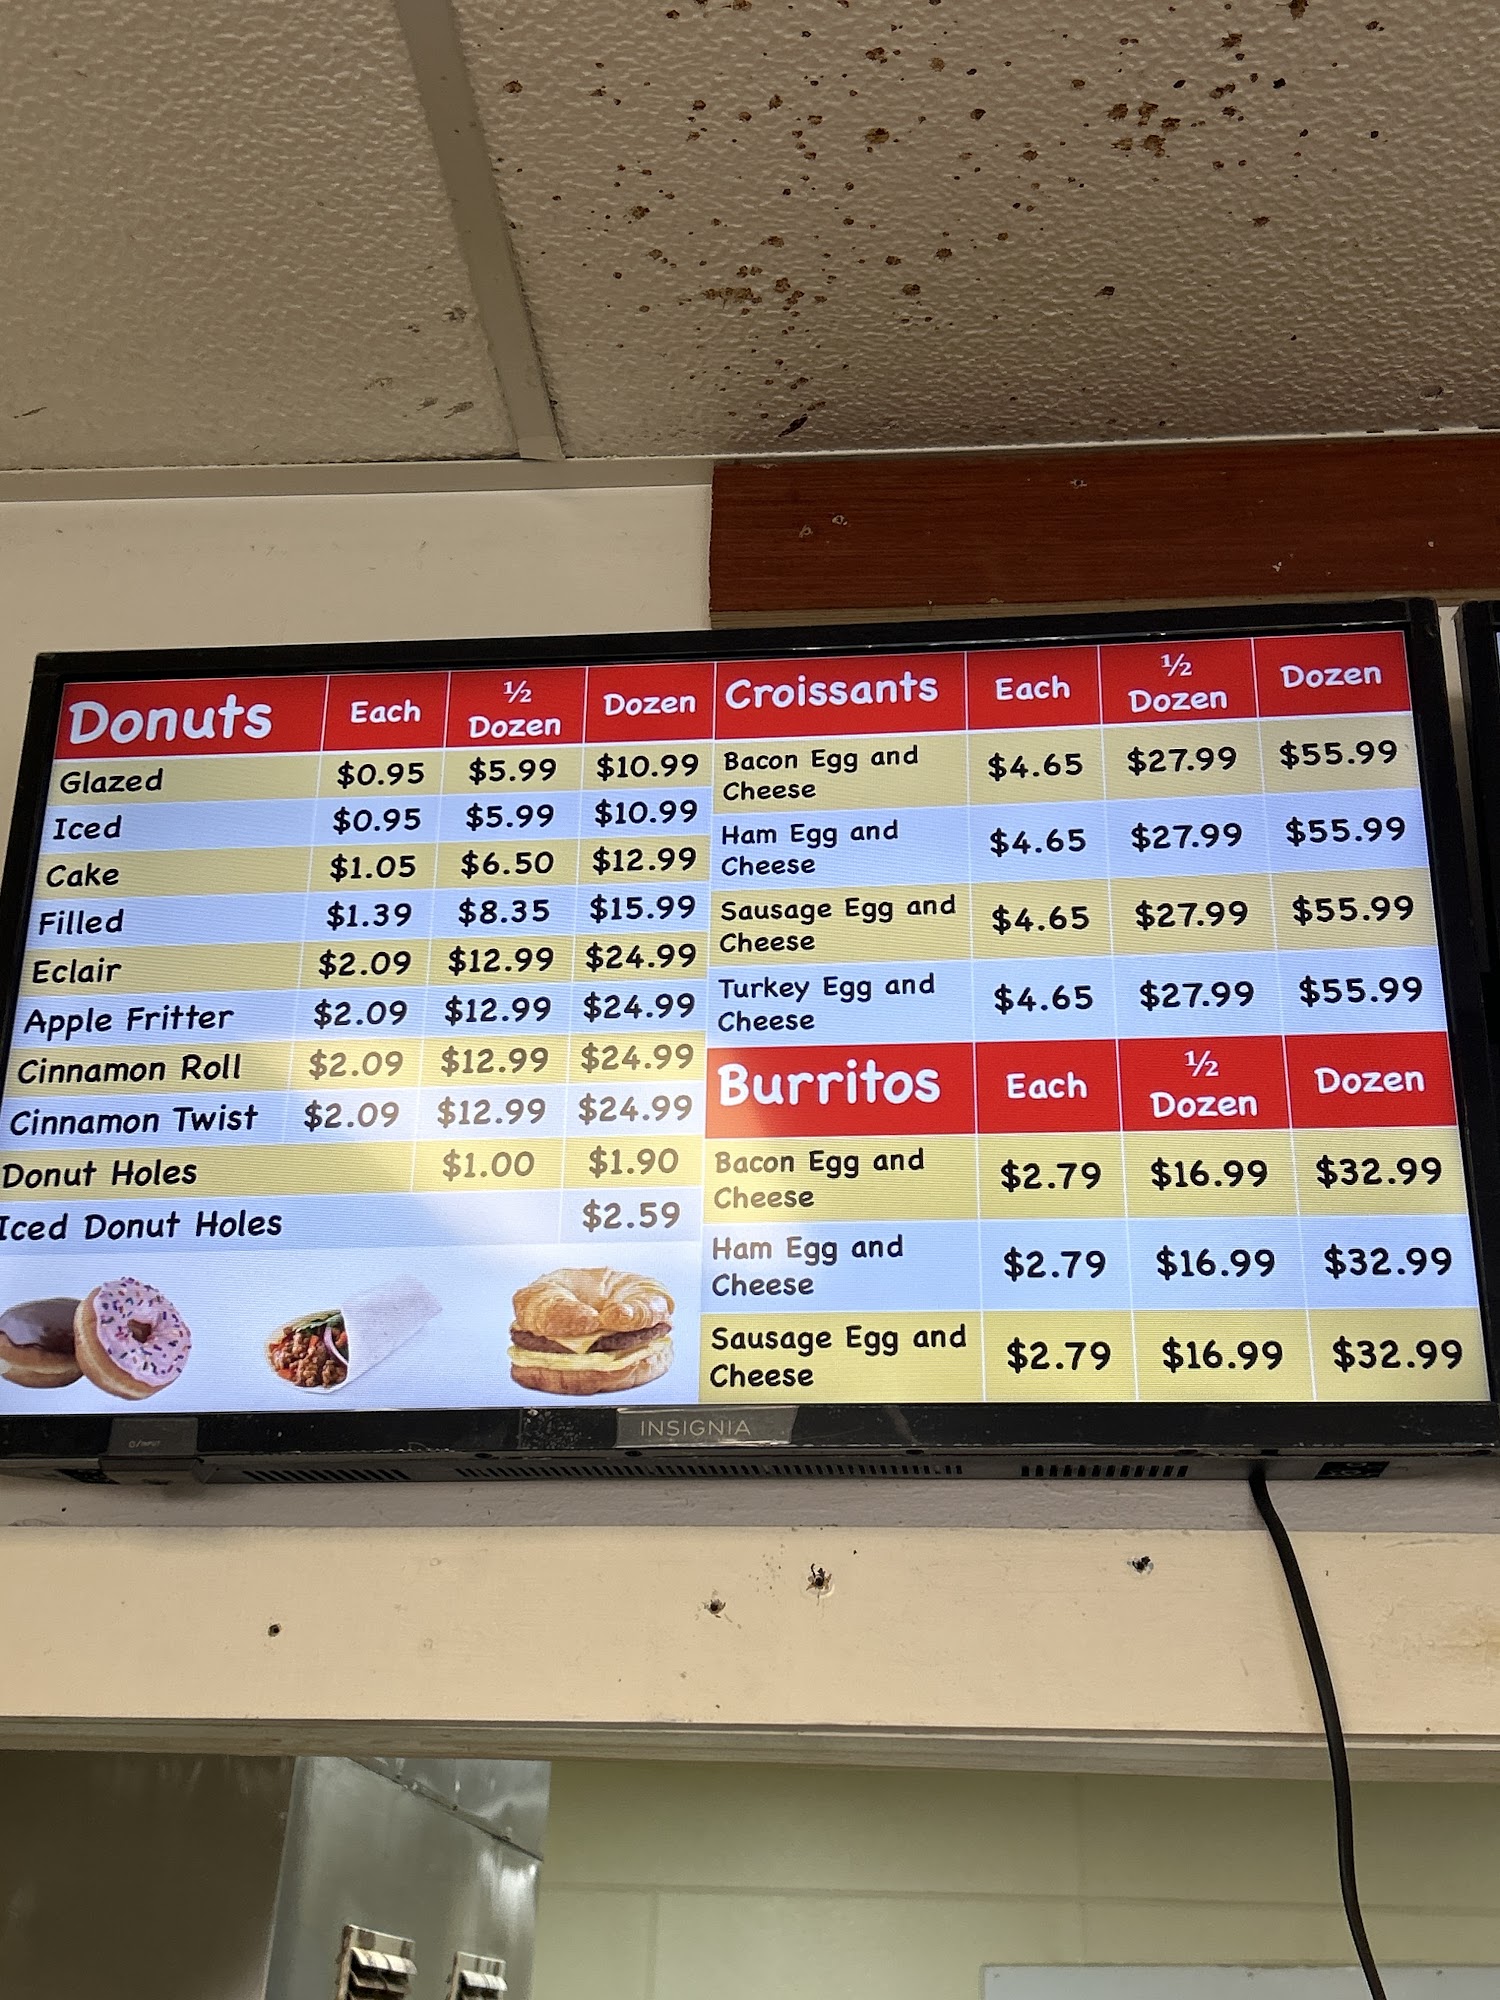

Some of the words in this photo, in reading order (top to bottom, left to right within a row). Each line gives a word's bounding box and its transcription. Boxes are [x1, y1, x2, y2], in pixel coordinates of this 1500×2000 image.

[726, 672, 937, 709] Croissants
[995, 675, 1070, 700] Each
[1280, 665, 1381, 688] Dozen
[351, 700, 420, 723] Each
[604, 694, 695, 715] Dozen
[1128, 690, 1227, 712] Dozen
[70, 694, 271, 744] Donuts
[469, 716, 560, 738] Dozen
[597, 753, 698, 781] $10.99
[724, 752, 797, 770] Bacon
[812, 749, 857, 773] Egg
[871, 745, 918, 765] and
[988, 753, 1082, 781] $4.65
[1128, 747, 1236, 776] $27.99
[1280, 740, 1397, 770] $55.99
[60, 768, 163, 794] Glazed
[337, 761, 424, 789] $0.95
[469, 757, 556, 785] $5.99
[724, 781, 816, 800] Cheese
[53, 815, 122, 840] Iced
[333, 807, 420, 835] $0.95
[466, 803, 553, 831] $5.99
[595, 799, 697, 827] $10.99
[722, 826, 776, 845] Ham
[791, 824, 837, 848] Egg
[851, 819, 898, 840] and
[990, 828, 1086, 857] $4.65
[1131, 823, 1242, 852] $27.99
[1286, 817, 1405, 847] $55.99
[47, 863, 119, 887] Cake
[330, 854, 415, 882] $1.05
[461, 850, 553, 879] $6.50
[593, 846, 696, 875] $12.99
[722, 856, 815, 876] Cheese
[39, 909, 124, 935] Filled
[327, 901, 411, 931] $1.39
[459, 897, 549, 927] $8.35
[590, 894, 695, 923] $15.99
[721, 902, 832, 925] Sausage
[845, 898, 893, 923] Egg
[907, 894, 955, 915] and
[992, 905, 1089, 935] $4.65
[1135, 900, 1248, 930] $27.99
[1293, 895, 1413, 926] $55.99
[586, 942, 696, 972] $24.99
[720, 932, 815, 952] Cheese
[33, 958, 122, 983] Eclair
[319, 949, 411, 979] $2.09
[449, 946, 553, 976] $12.99
[718, 977, 809, 1002] Turkey
[824, 976, 871, 1003] Egg
[886, 973, 934, 994] and
[994, 984, 1092, 1015] $4.65
[1140, 980, 1254, 1011] $27.99
[1299, 976, 1422, 1007] $55.99
[314, 999, 407, 1029] $2.09
[445, 995, 550, 1026] $12.99
[584, 991, 695, 1023] $24.99
[718, 1011, 814, 1032] Cheese
[24, 1008, 112, 1041] Apple
[127, 1005, 234, 1031] Fritter
[18, 1058, 165, 1084] Cinnamon
[182, 1054, 240, 1080] Roll
[309, 1049, 403, 1080] $2.09
[441, 1046, 548, 1077] $12.99
[581, 1042, 693, 1073] $24.99
[718, 1060, 941, 1106] Burritos
[1007, 1072, 1087, 1099] Each
[1314, 1068, 1424, 1094] Dozen
[10, 1109, 159, 1135] Cinnamon
[172, 1104, 258, 1132] Twist
[304, 1100, 398, 1132] $2.09
[438, 1096, 545, 1128] $12.99
[579, 1093, 692, 1125] $24.99
[1150, 1092, 1257, 1118] Dozen
[3, 1161, 97, 1188] Donut
[112, 1159, 196, 1186] Holes
[443, 1149, 534, 1182] $1.00
[589, 1145, 678, 1179] $1.90
[715, 1152, 794, 1173] Bacon
[809, 1150, 858, 1178] Egg
[874, 1148, 924, 1170] and
[1001, 1159, 1101, 1192] $2.79
[1151, 1157, 1267, 1191] $16.99
[1316, 1155, 1441, 1189] $32.99
[715, 1187, 814, 1208] Cheese
[0, 1213, 68, 1240] Iced
[85, 1211, 180, 1240] Donut
[196, 1210, 282, 1237] Holes
[583, 1199, 679, 1232] $2.59
[713, 1237, 771, 1260] Ham
[787, 1237, 837, 1266] Egg
[852, 1234, 903, 1257] and
[1004, 1247, 1105, 1282] $2.79
[1157, 1245, 1275, 1280] $16.99
[1324, 1244, 1451, 1279] $32.99
[712, 1273, 814, 1296] Cheese
[712, 1327, 832, 1357] Sausage
[846, 1325, 898, 1356] Egg
[913, 1324, 966, 1348] and
[1007, 1337, 1110, 1374] $2.79
[1163, 1336, 1282, 1373] $16.99
[1333, 1336, 1462, 1373] $32.99
[710, 1364, 813, 1387] Cheese
[640, 1420, 751, 1436] INSIGNIA
